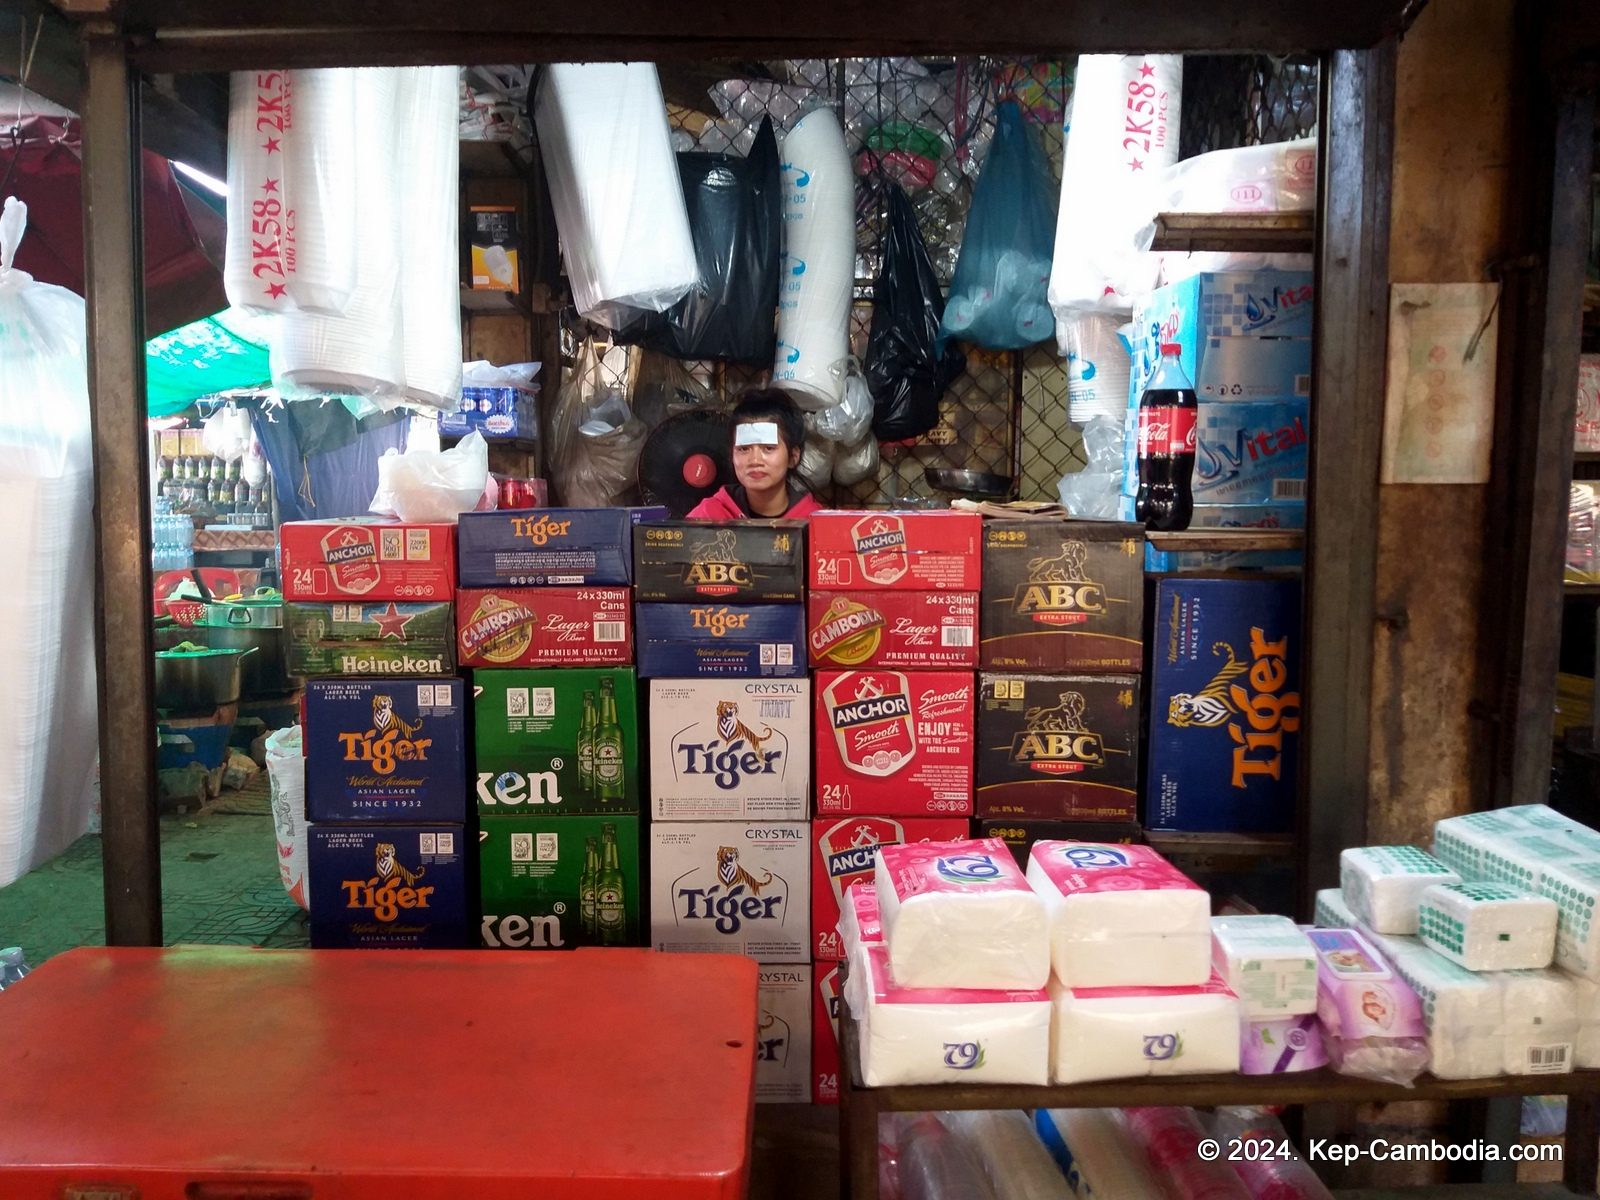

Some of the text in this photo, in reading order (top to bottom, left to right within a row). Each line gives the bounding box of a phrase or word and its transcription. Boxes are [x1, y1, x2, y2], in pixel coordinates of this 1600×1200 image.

[284, 104, 292, 129] 100
[1123, 81, 1157, 153] 2K58
[1155, 91, 1169, 148] 100 PCS
[253, 199, 285, 279] 2K58
[285, 209, 297, 273] 100 PCS
[1217, 416, 1307, 467] Vital
[510, 515, 571, 545] Tiger
[859, 533, 903, 550] ANCHOR
[328, 545, 373, 562] ANCHOR
[817, 558, 836, 573] 24
[293, 569, 312, 584] 24
[684, 564, 749, 584] ABC
[601, 601, 625, 610] Cans
[949, 606, 974, 614] Cans
[1018, 585, 1102, 612] ABC
[462, 605, 534, 648] CAMBODIA
[541, 614, 591, 641] Lager
[690, 607, 749, 637] Tiger
[812, 609, 883, 649] CAMBODIA
[890, 618, 938, 645] Lager
[538, 648, 618, 656] PREMIUM QUALITY
[930, 652, 965, 660] QUALITY
[1190, 626, 1199, 660] SINCE
[341, 656, 443, 673] Heineken
[745, 684, 802, 694] CRYSTAL
[919, 686, 969, 710] Smooth
[837, 698, 907, 725] ANCHOR
[1228, 626, 1300, 789] Tiger
[855, 721, 900, 747] Smooth
[918, 722, 951, 736] ENJOY
[338, 729, 432, 775] Tiger
[1015, 734, 1098, 761] ABC
[678, 740, 782, 790] Tiger
[477, 771, 563, 805] ken
[823, 785, 840, 799] 24
[745, 829, 803, 839] CRYSTAL
[341, 877, 435, 922] Tiger
[678, 885, 782, 935] Tiger
[481, 914, 565, 947] ken
[819, 932, 837, 946] 24
[943, 1043, 978, 1070] 79
[1143, 1034, 1177, 1060] 79
[819, 1074, 837, 1088] 24
